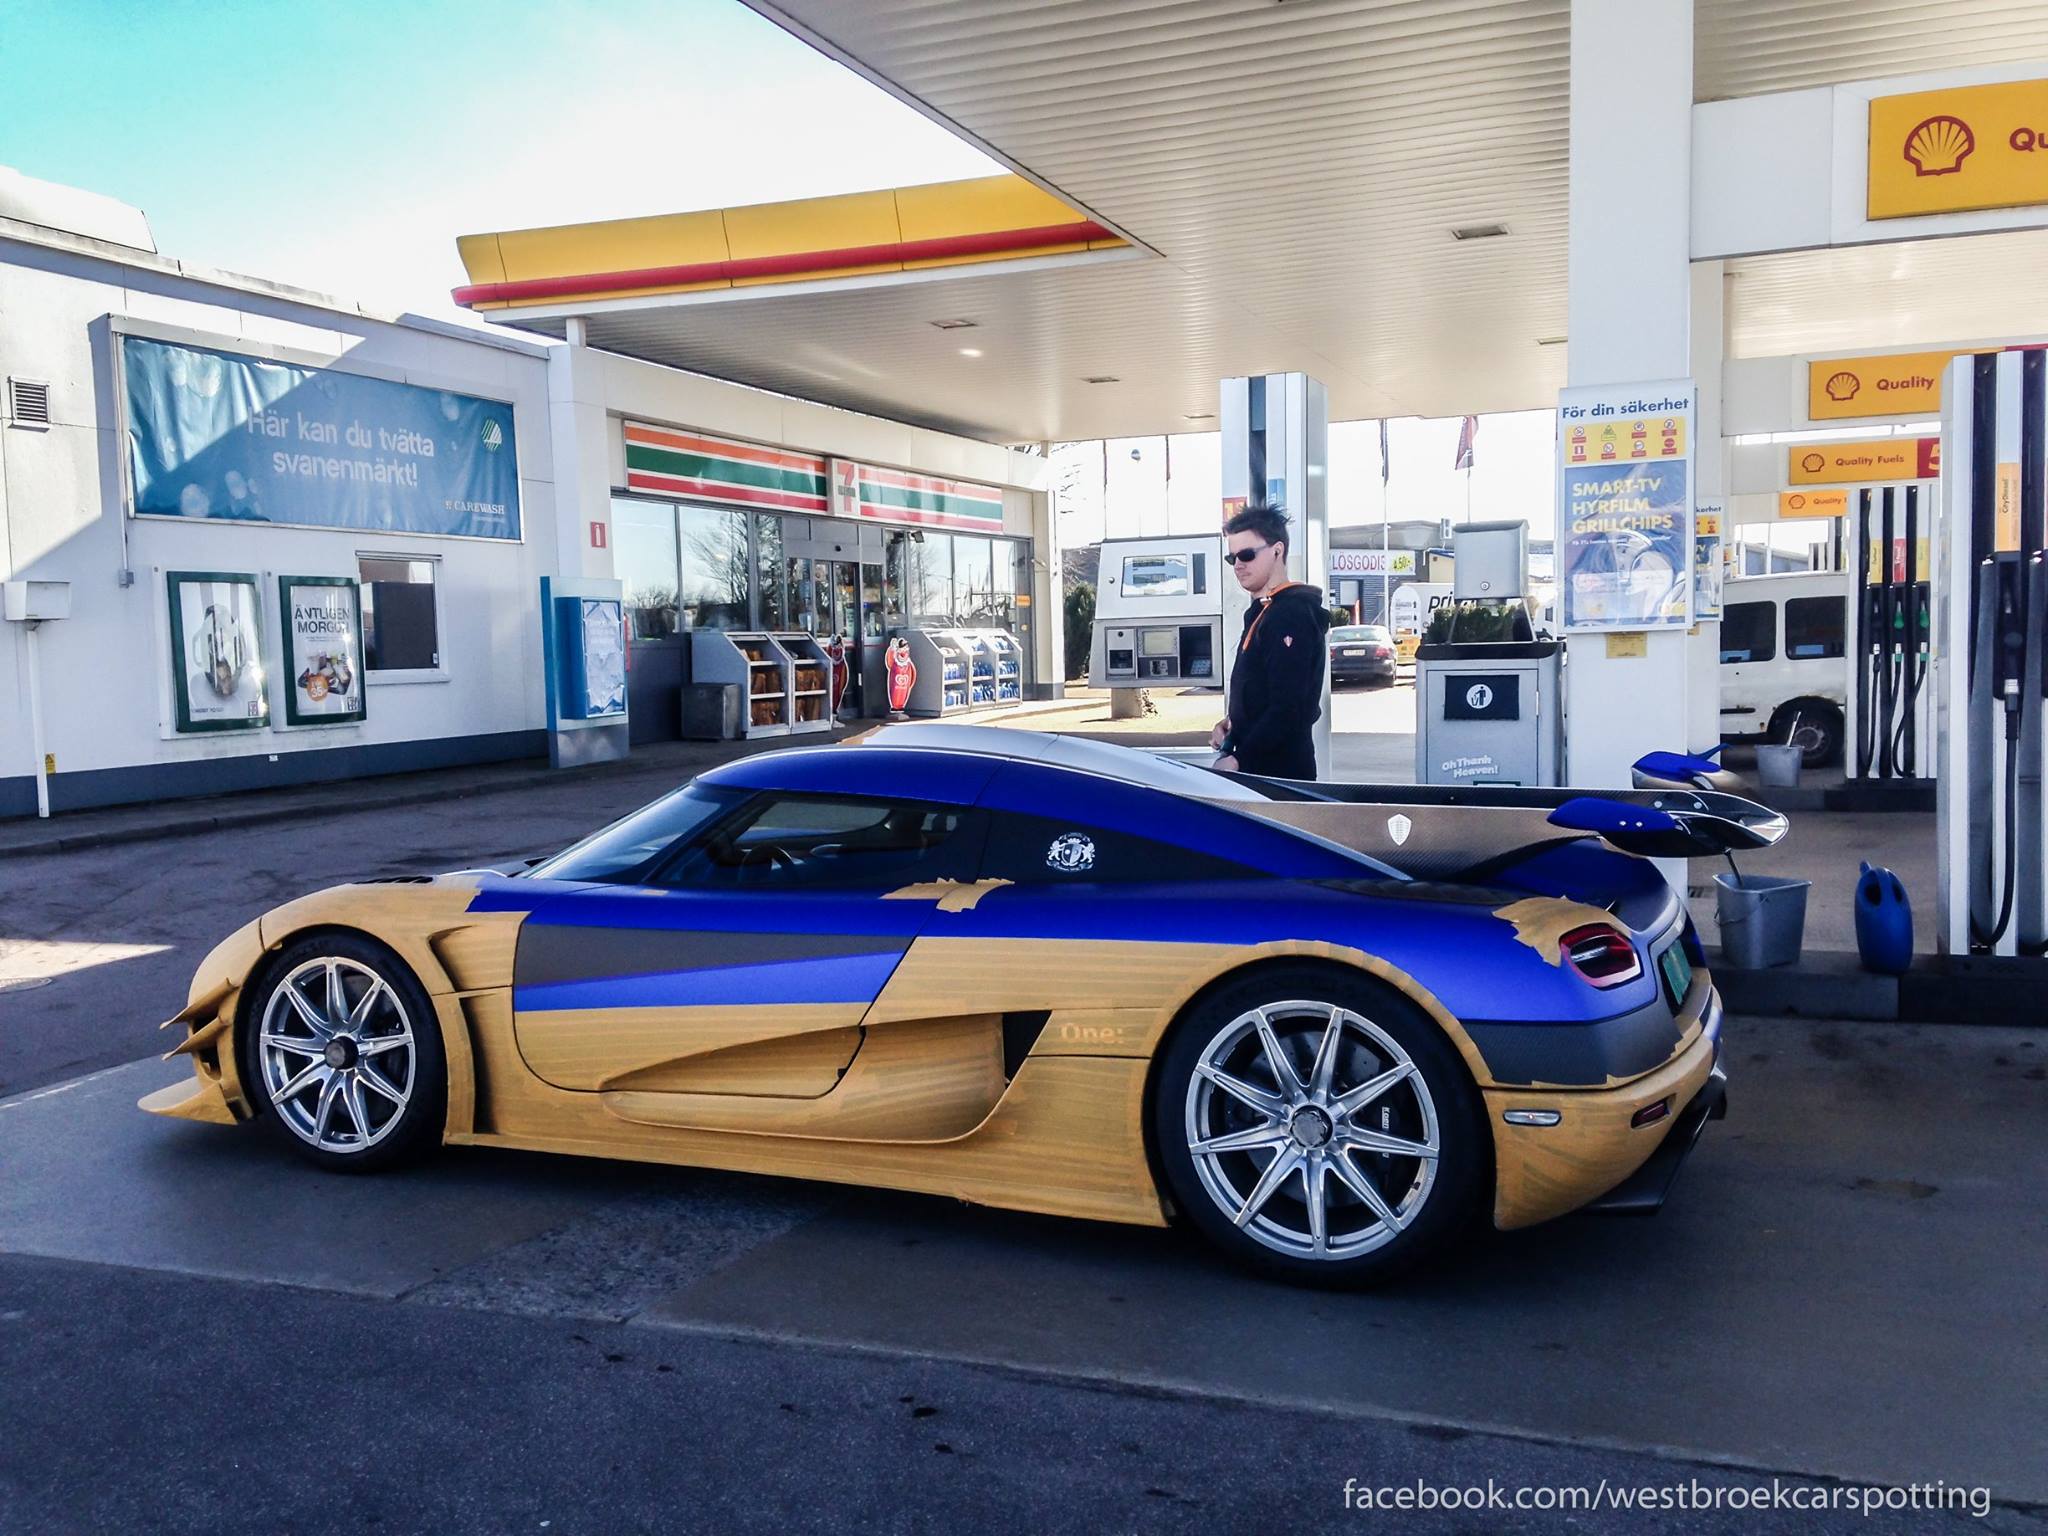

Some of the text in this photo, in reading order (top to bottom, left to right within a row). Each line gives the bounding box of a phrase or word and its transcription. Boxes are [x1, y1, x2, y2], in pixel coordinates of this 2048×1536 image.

[1876, 376, 1934, 391] Quality
[1562, 397, 1689, 418] För din säkerhet
[248, 406, 434, 457] Här kan du tvätta
[272, 451, 418, 487] svanenmärkt!
[1835, 457, 1873, 467] Quality
[1877, 454, 1904, 464] Fuels
[1573, 478, 1661, 497] SMART-TV
[2002, 479, 2010, 514] CityDiesel
[454, 501, 505, 515] CAREWASH
[1572, 497, 1650, 515] HYRFILM
[1813, 497, 1841, 506] Quality
[1572, 514, 1673, 534] GRILLCHIPS
